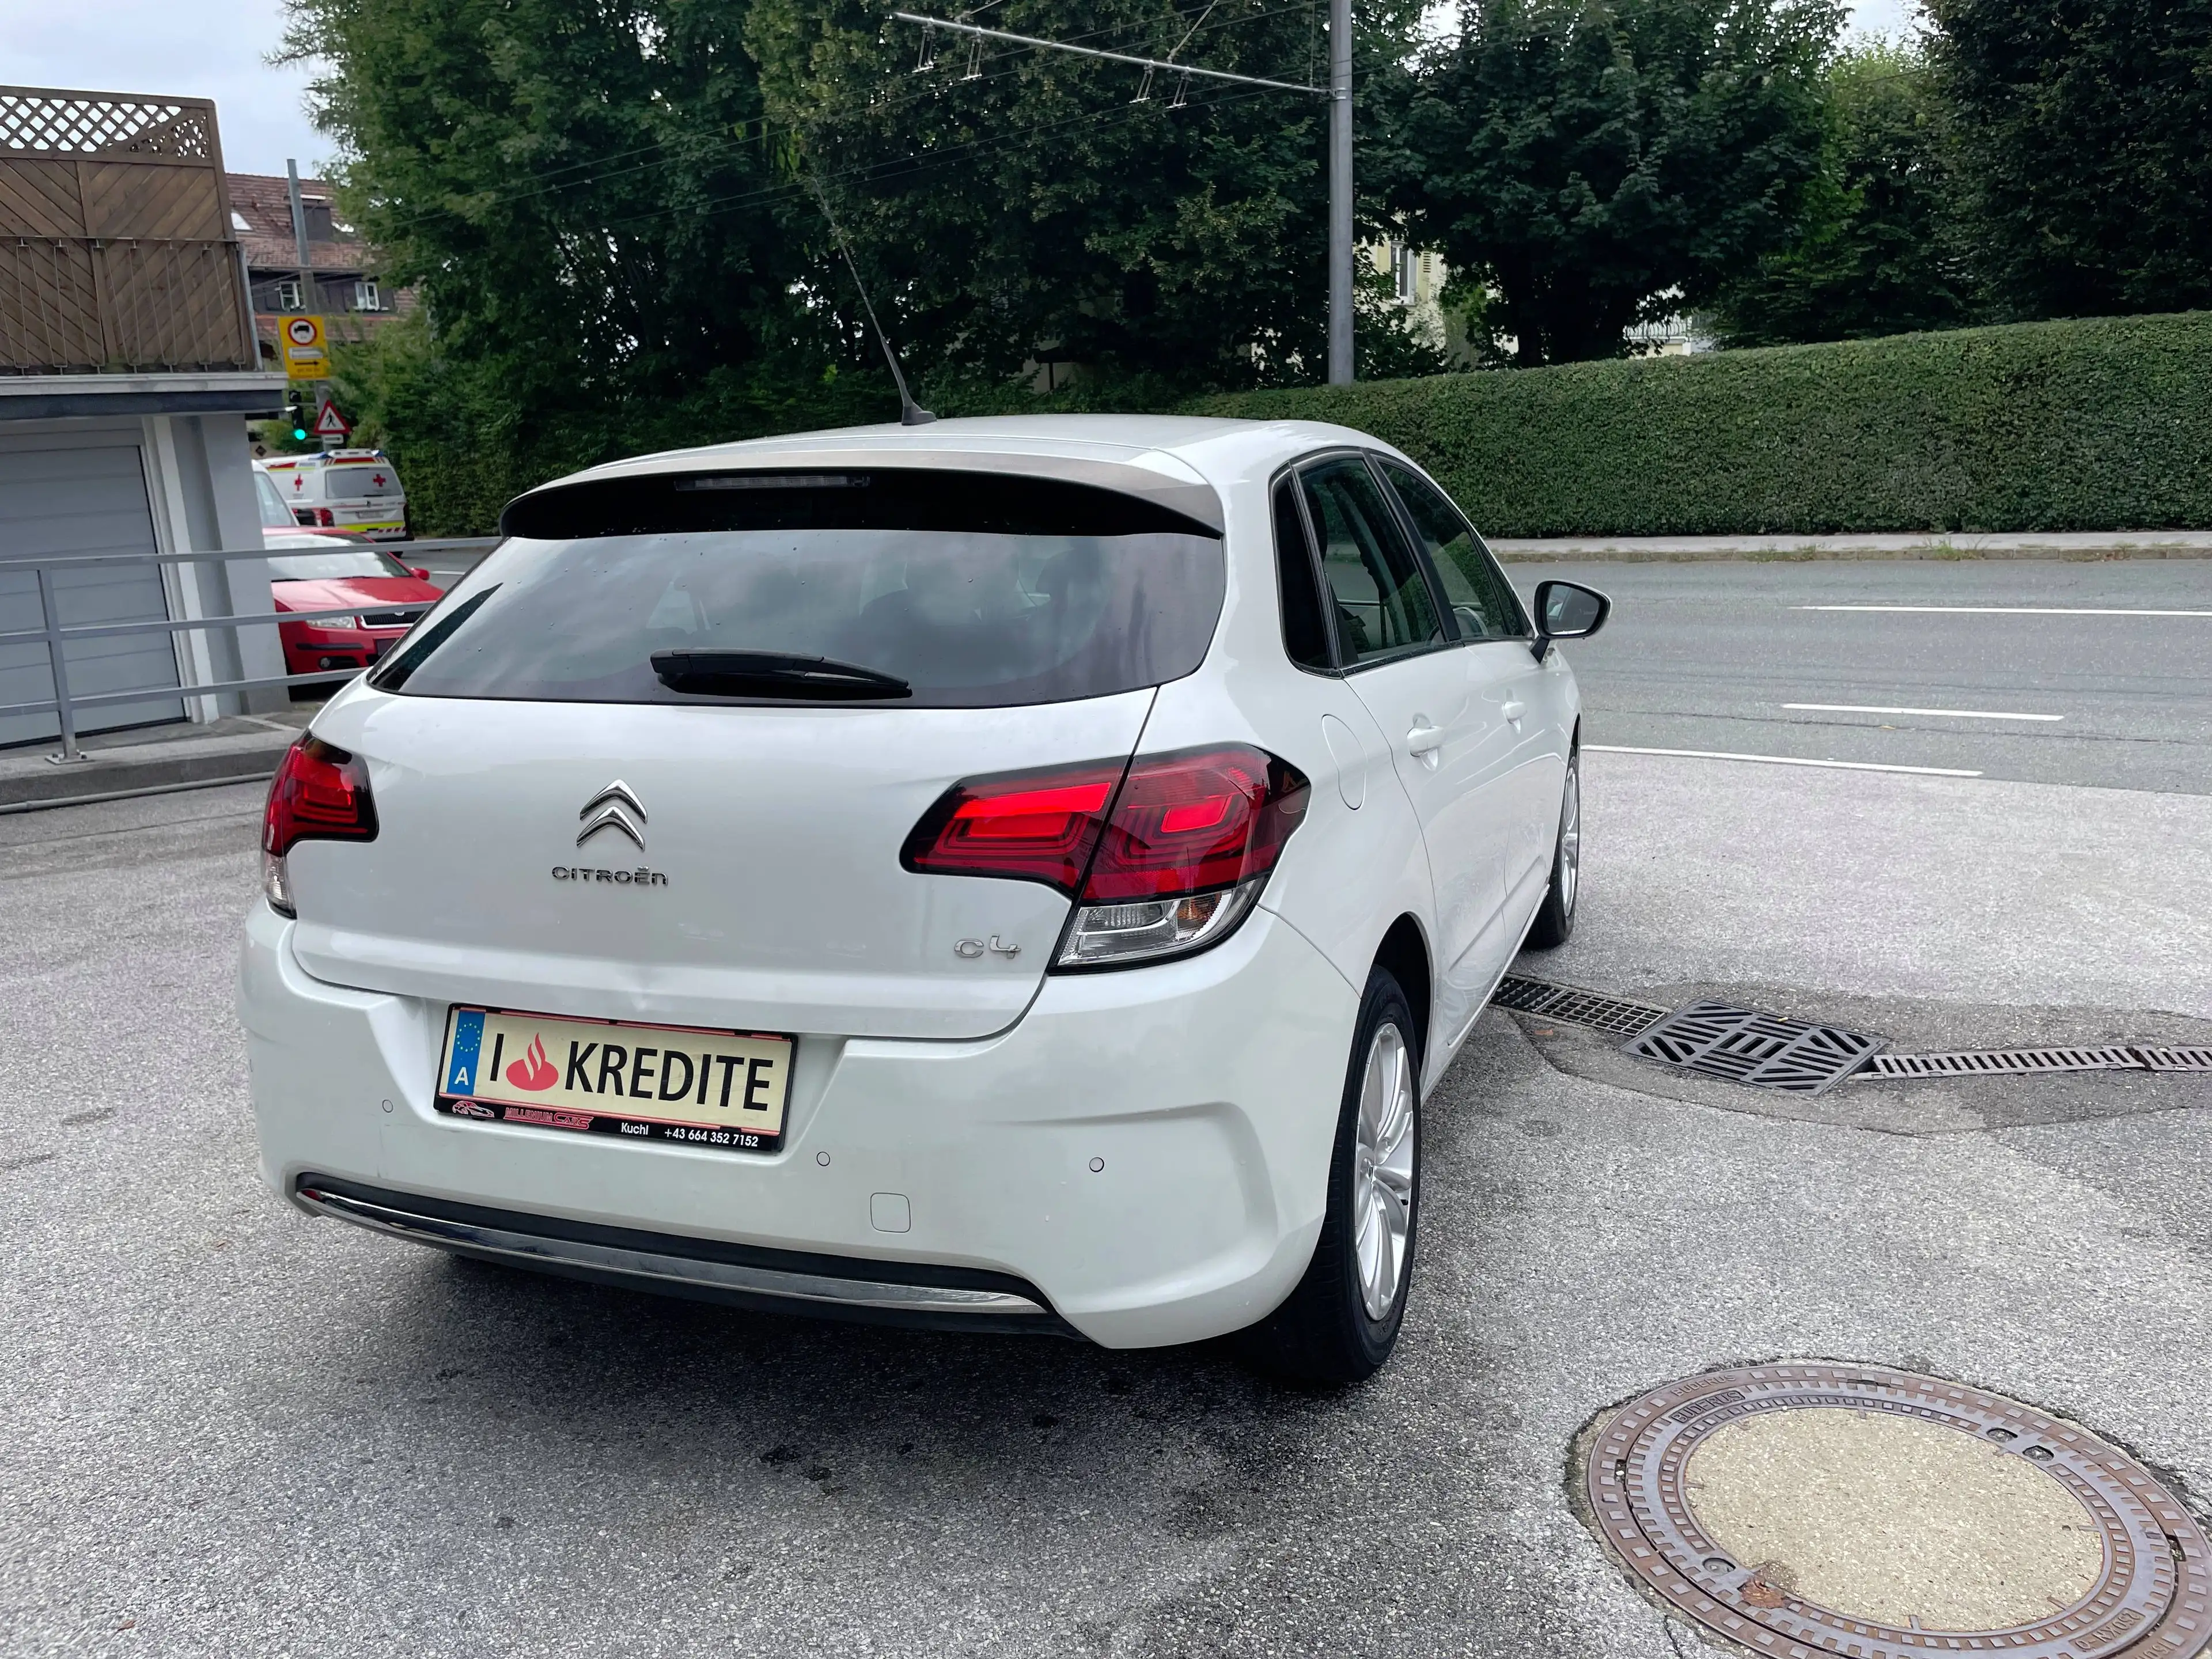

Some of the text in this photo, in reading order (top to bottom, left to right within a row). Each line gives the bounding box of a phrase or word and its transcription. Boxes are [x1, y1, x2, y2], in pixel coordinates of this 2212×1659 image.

[454, 1067, 469, 1086] A
[490, 1033, 774, 1112] I KREDITE
[505, 1107, 553, 1122] MILLENIUM
[621, 1122, 649, 1135] Kuchl
[664, 1128, 759, 1147] +43 664 352 7152
[1671, 1374, 1736, 1397] BUDERUS
[1671, 1391, 1740, 1423] BUDERUS
